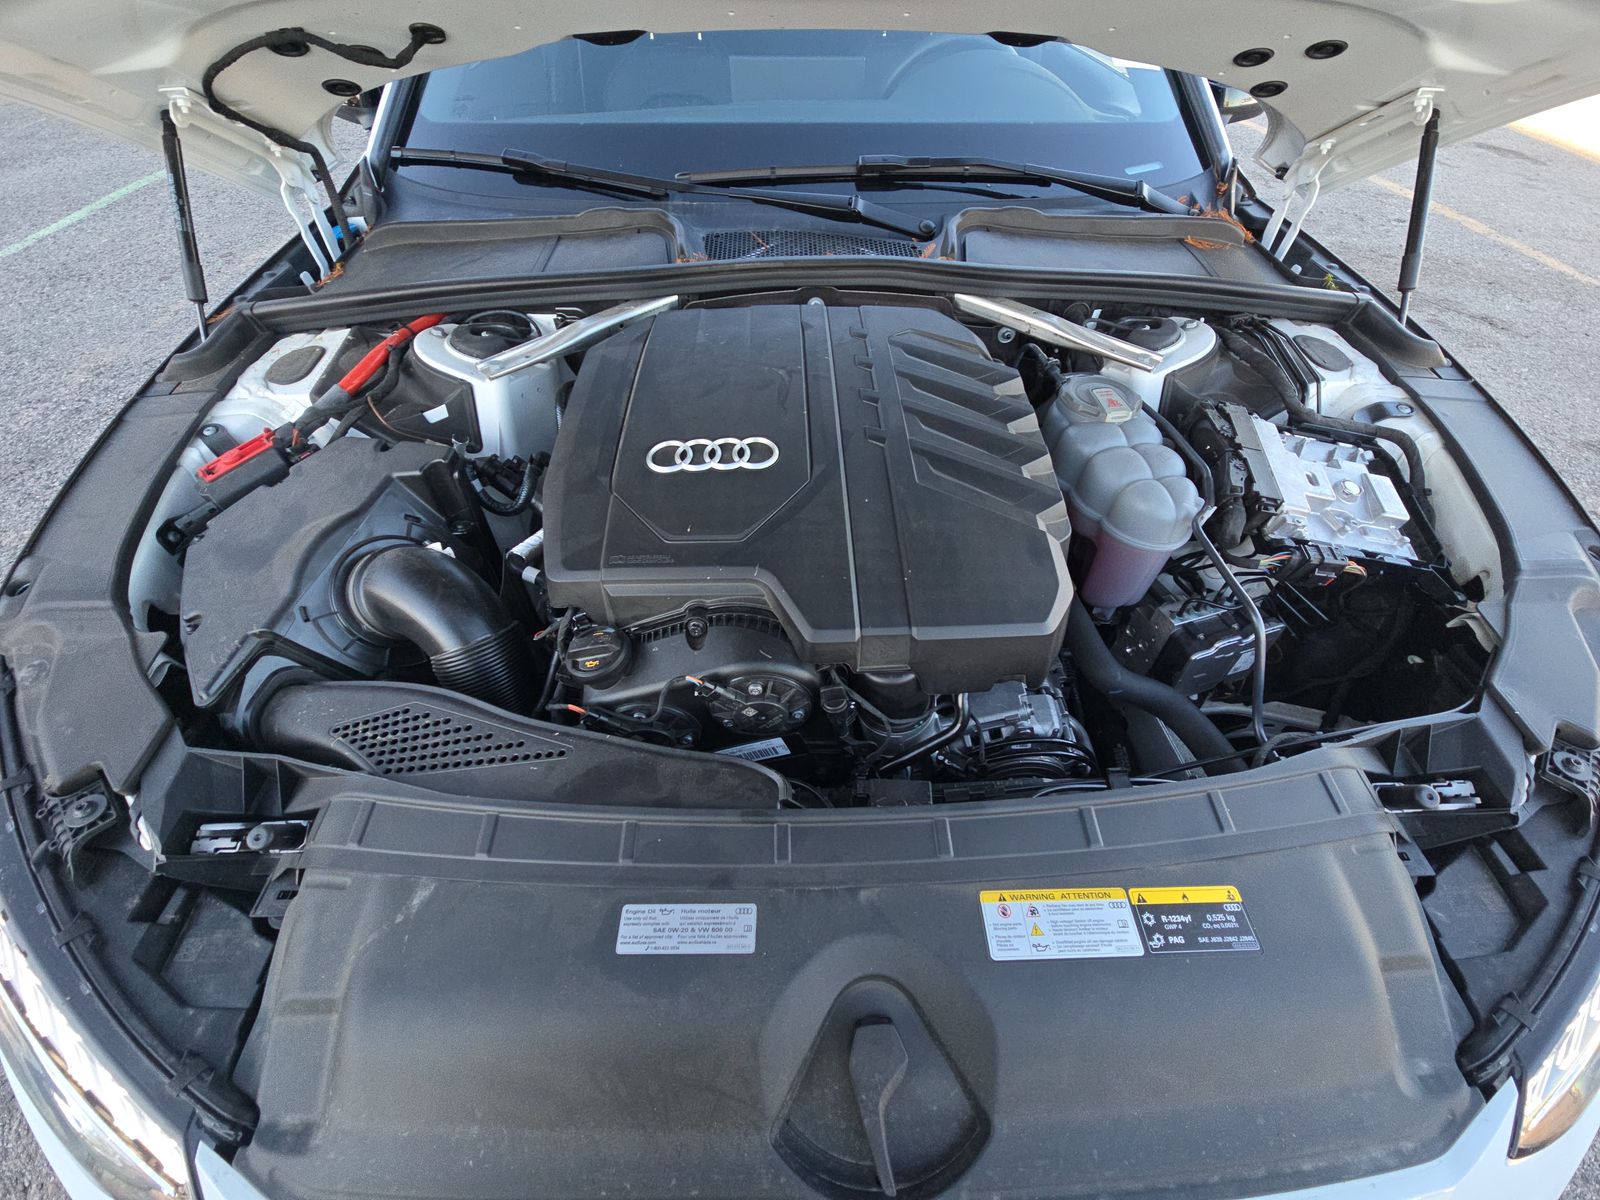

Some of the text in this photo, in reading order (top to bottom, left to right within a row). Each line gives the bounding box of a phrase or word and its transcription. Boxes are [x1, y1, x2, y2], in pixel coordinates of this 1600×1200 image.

[1008, 892, 1111, 901] WARNING ATTENTION
[1161, 914, 1192, 923] R-1234yf
[1226, 913, 1236, 923] kg
[1168, 936, 1185, 944] PAG
